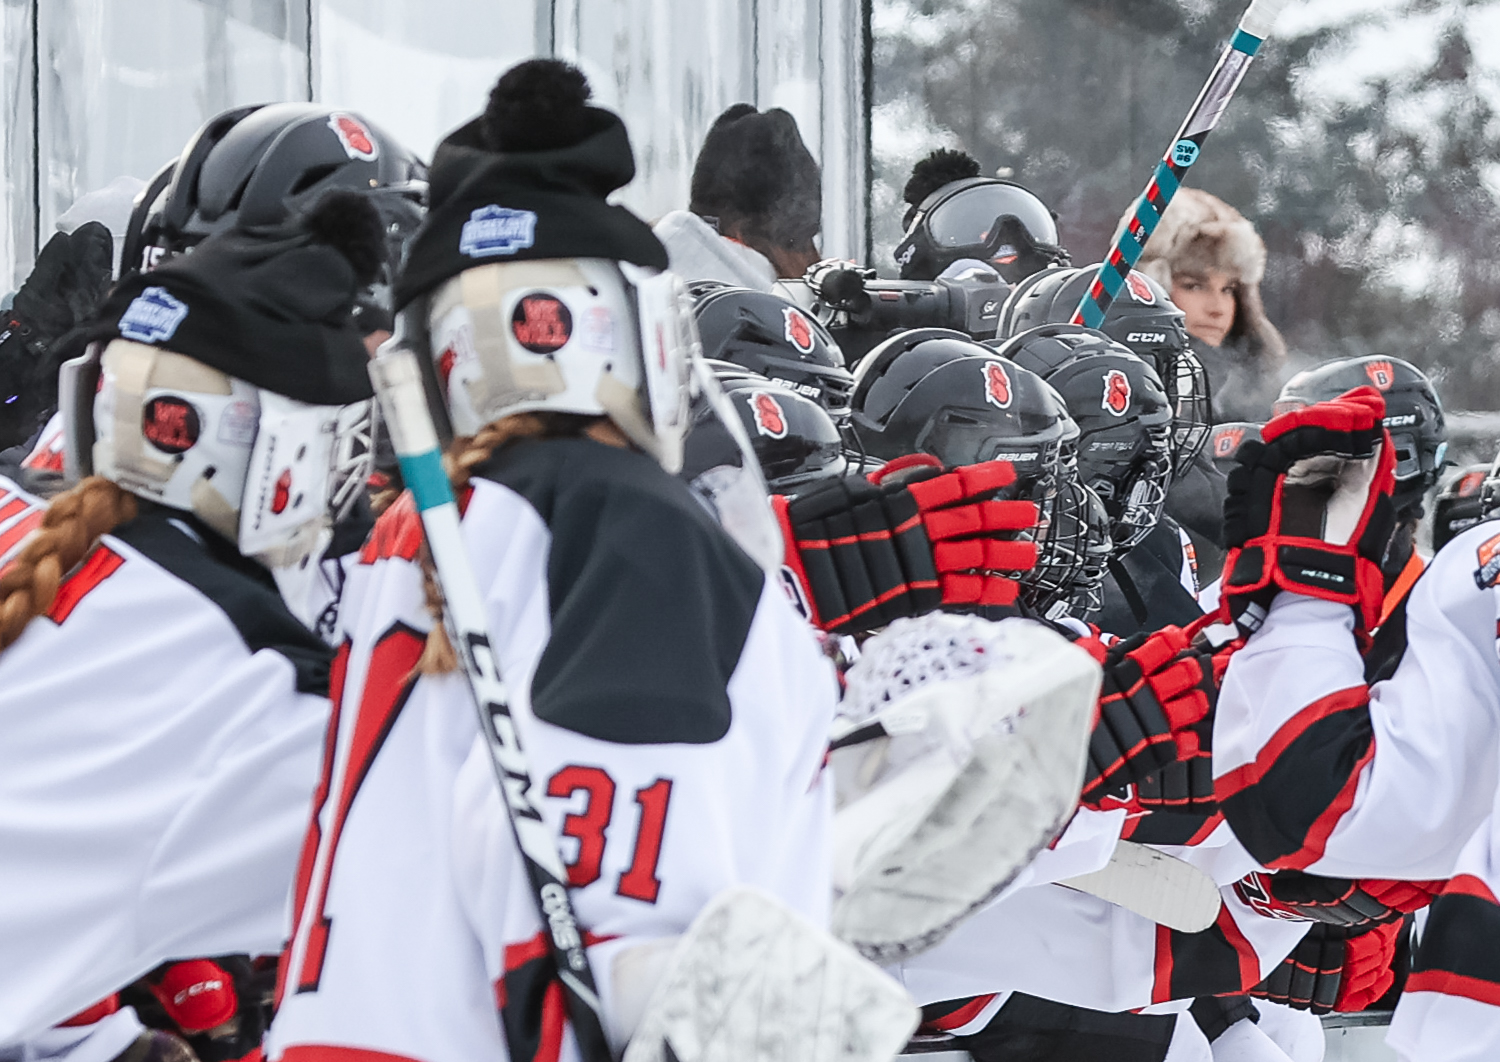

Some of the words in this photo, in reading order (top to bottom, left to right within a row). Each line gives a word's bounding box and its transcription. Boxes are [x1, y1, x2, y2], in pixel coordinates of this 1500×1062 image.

[1175, 143, 1196, 155] SW
[1176, 153, 1191, 163] #6
[1126, 332, 1166, 343] CCM
[771, 377, 822, 398] BAUER
[995, 452, 1038, 462] BAUER
[466, 632, 543, 823] CCM
[546, 764, 674, 904] 31
